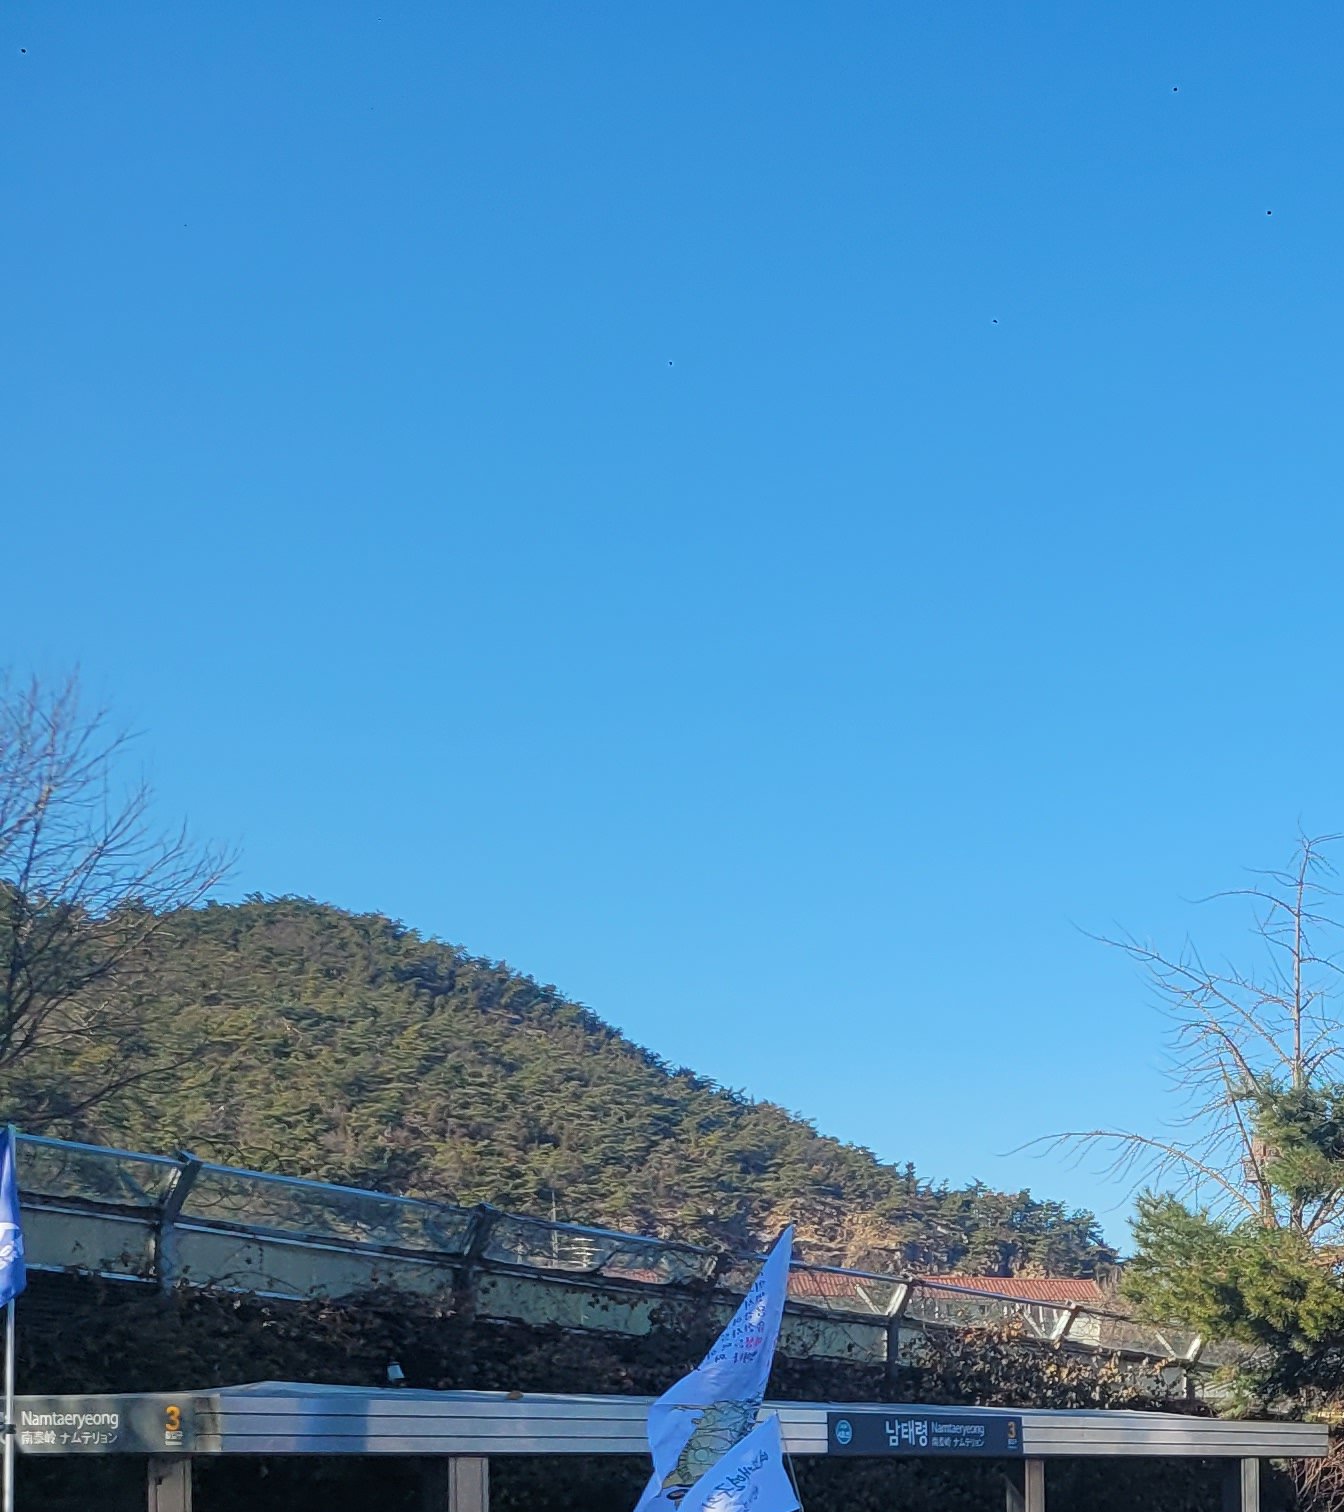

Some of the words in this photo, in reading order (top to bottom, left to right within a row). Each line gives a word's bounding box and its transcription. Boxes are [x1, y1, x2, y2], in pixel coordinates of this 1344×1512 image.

[21, 1411, 119, 1430] Namtaeryeong
[165, 1405, 181, 1431] 3
[885, 1420, 928, 1447] 남태령
[931, 1422, 985, 1437] Namtaeryeong
[1008, 1422, 1016, 1438] 3
